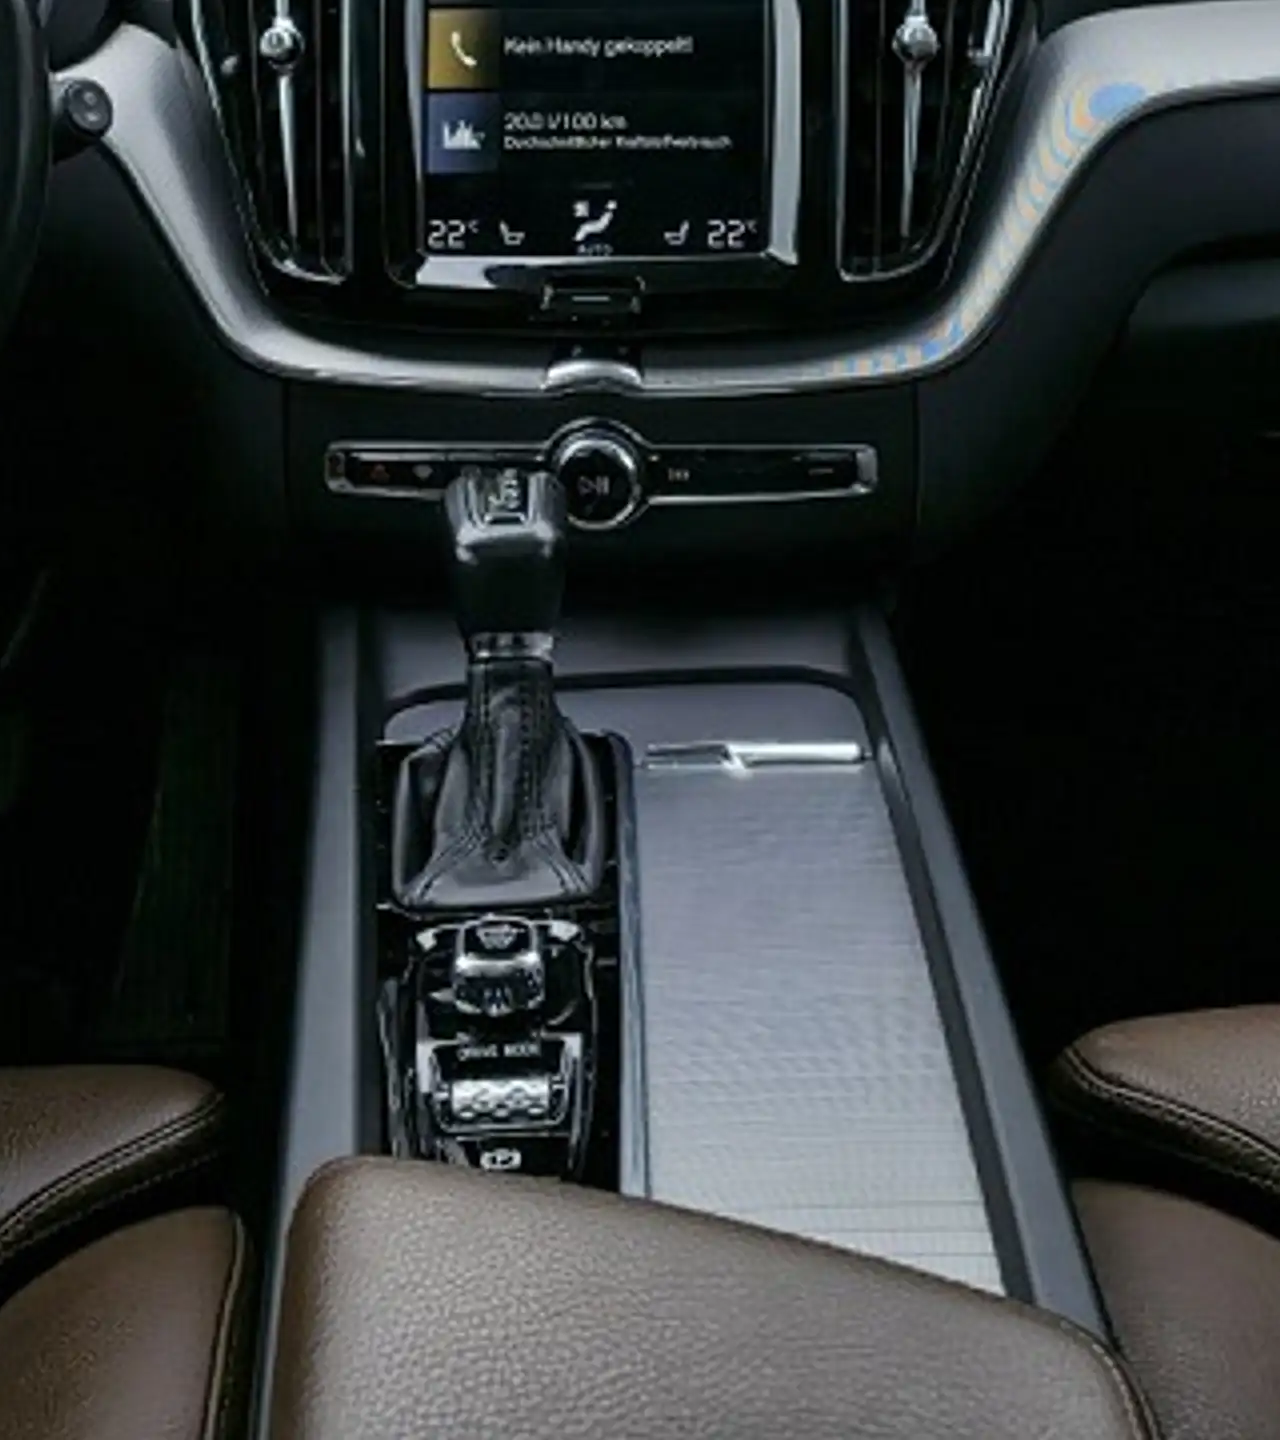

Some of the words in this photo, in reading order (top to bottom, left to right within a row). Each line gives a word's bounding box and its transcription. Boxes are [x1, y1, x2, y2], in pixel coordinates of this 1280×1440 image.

[504, 36, 543, 55] Kein
[545, 36, 601, 57] Handy
[600, 112, 629, 131] km
